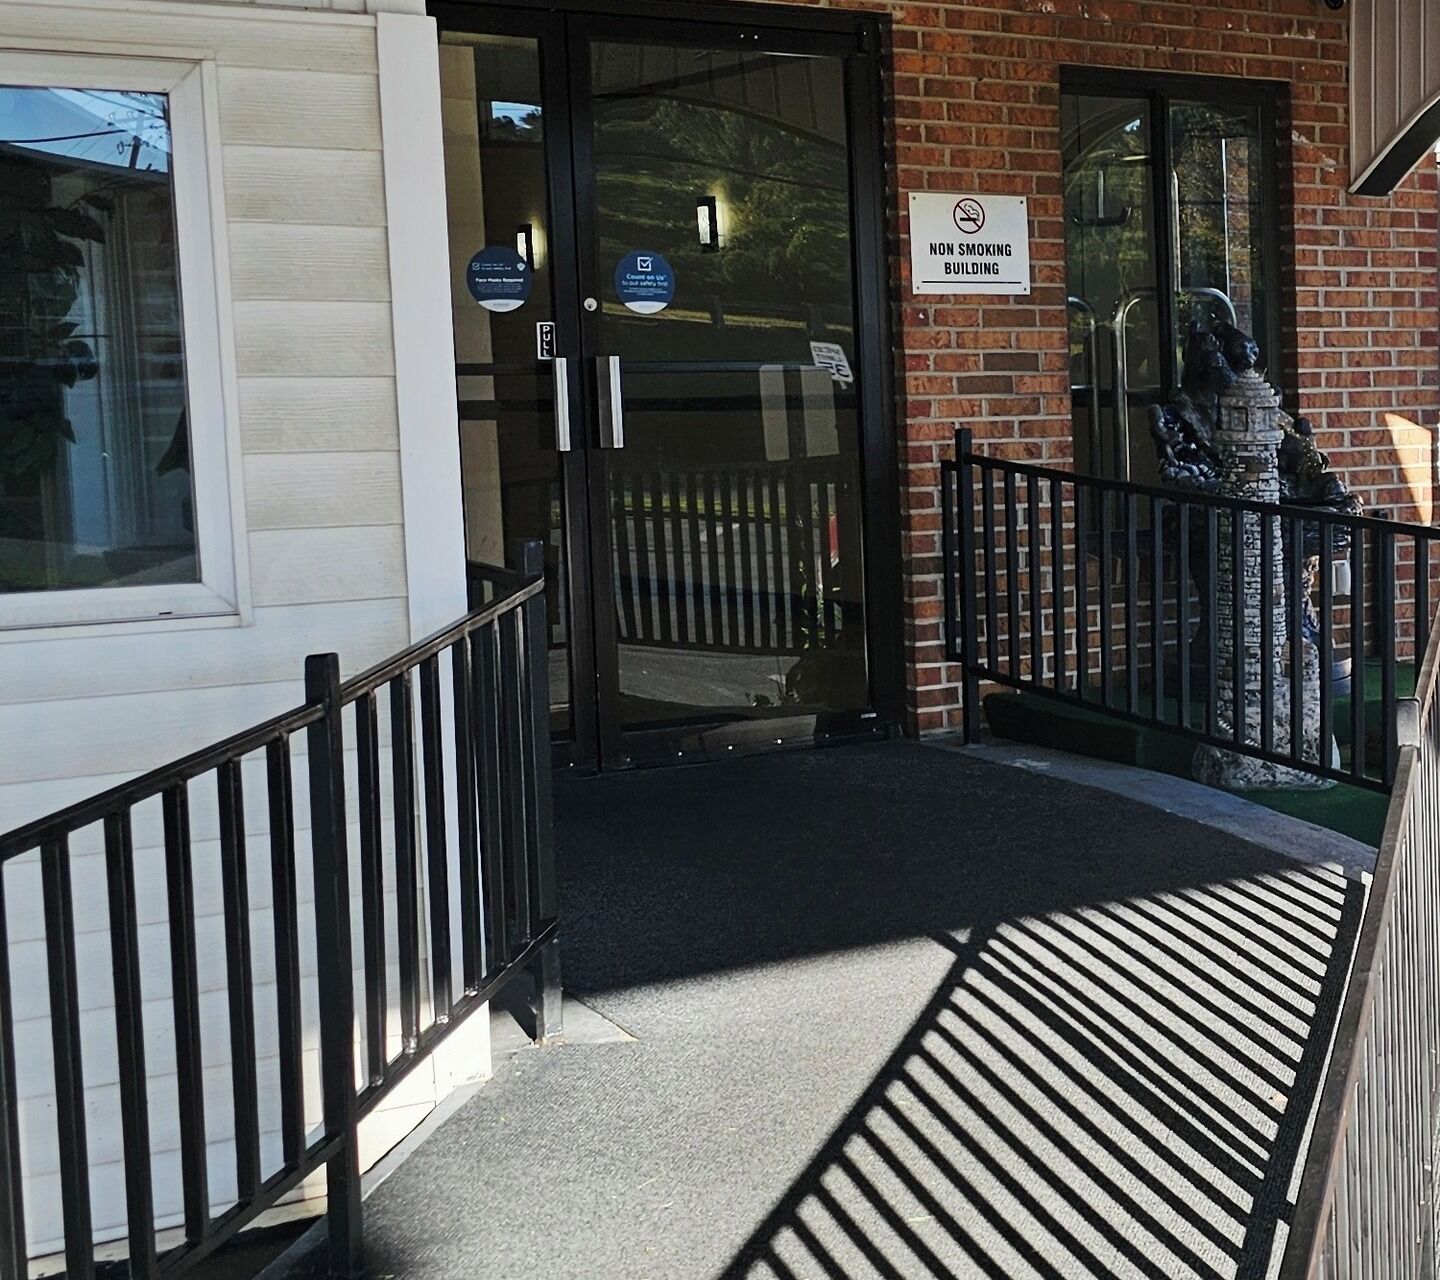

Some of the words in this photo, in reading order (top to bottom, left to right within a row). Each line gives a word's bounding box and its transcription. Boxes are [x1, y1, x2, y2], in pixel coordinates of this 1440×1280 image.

[929, 242, 954, 256] NON
[958, 242, 1012, 257] SMOKING
[944, 261, 1000, 275] BUILDING
[542, 325, 551, 357] PULL
